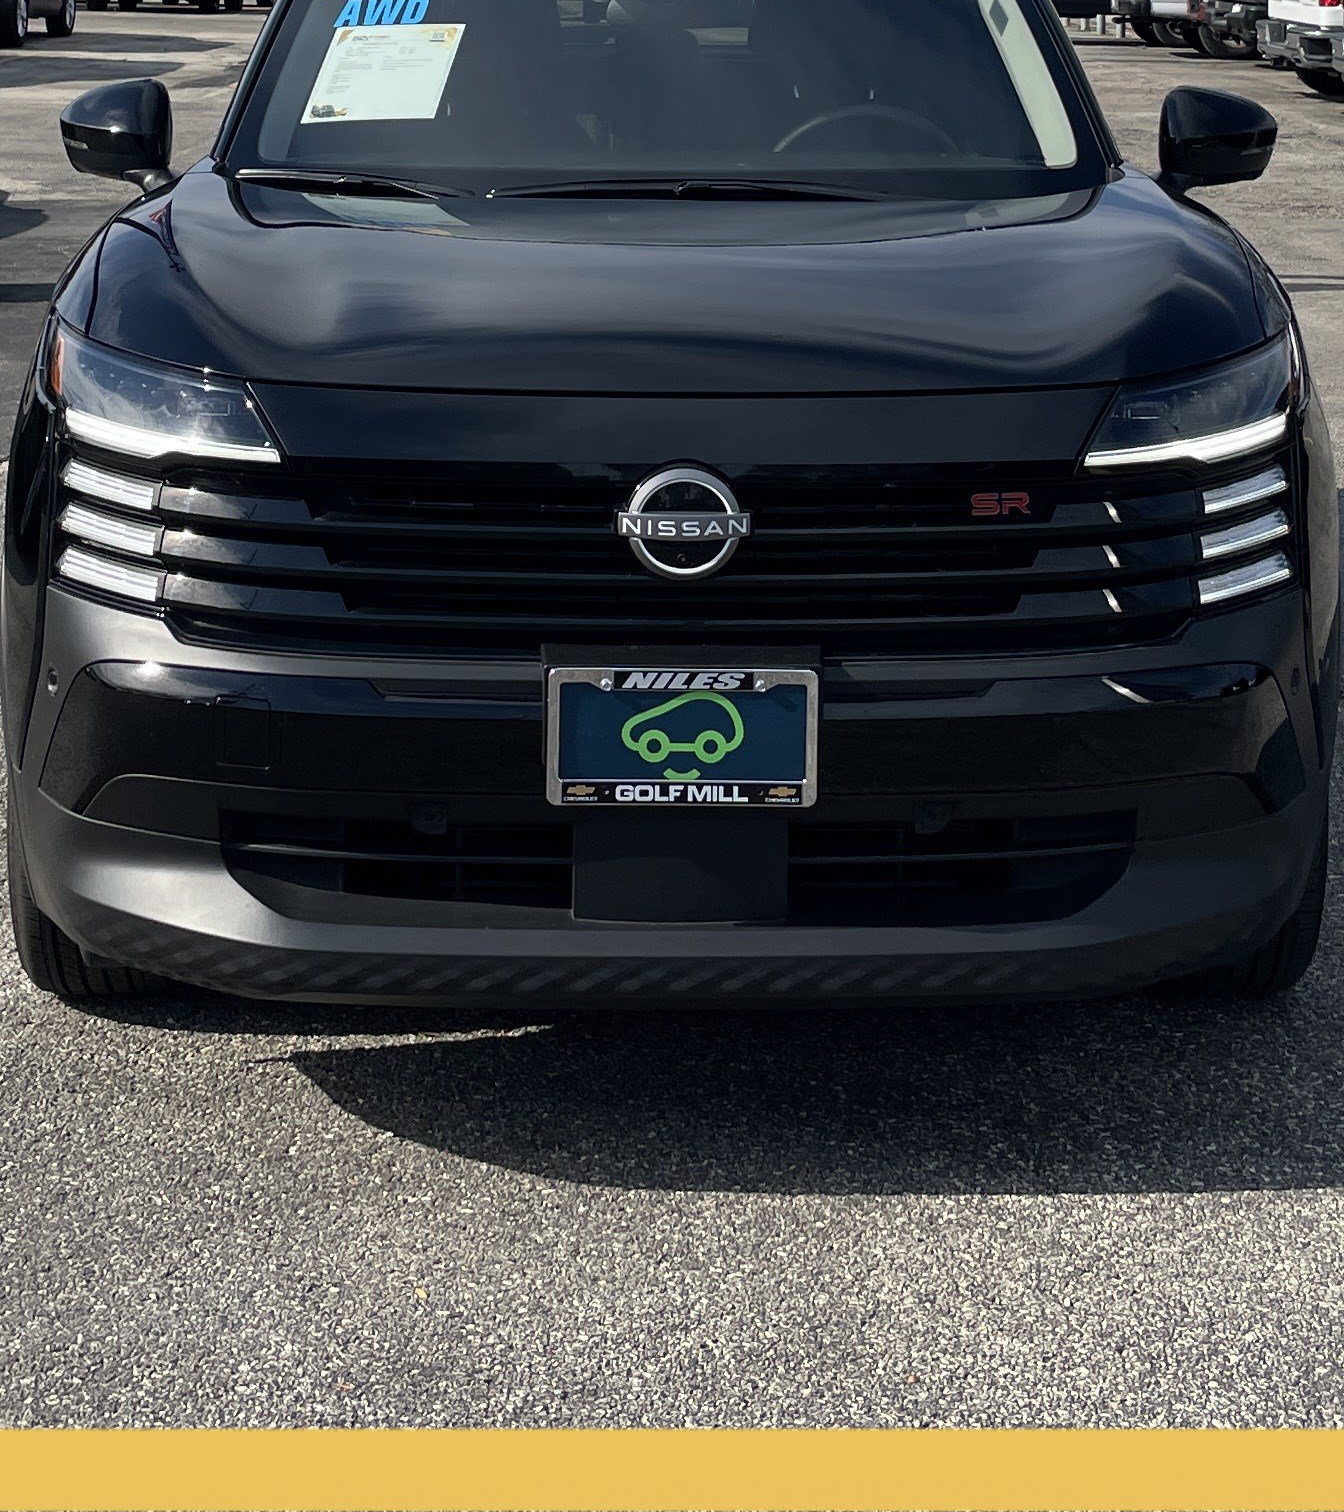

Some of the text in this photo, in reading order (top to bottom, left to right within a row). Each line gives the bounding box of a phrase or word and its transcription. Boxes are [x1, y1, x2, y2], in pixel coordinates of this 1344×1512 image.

[970, 492, 1032, 516] SR
[620, 516, 748, 538] NISSAN
[621, 672, 746, 690] NILES
[615, 784, 749, 803] GOLF MILL
